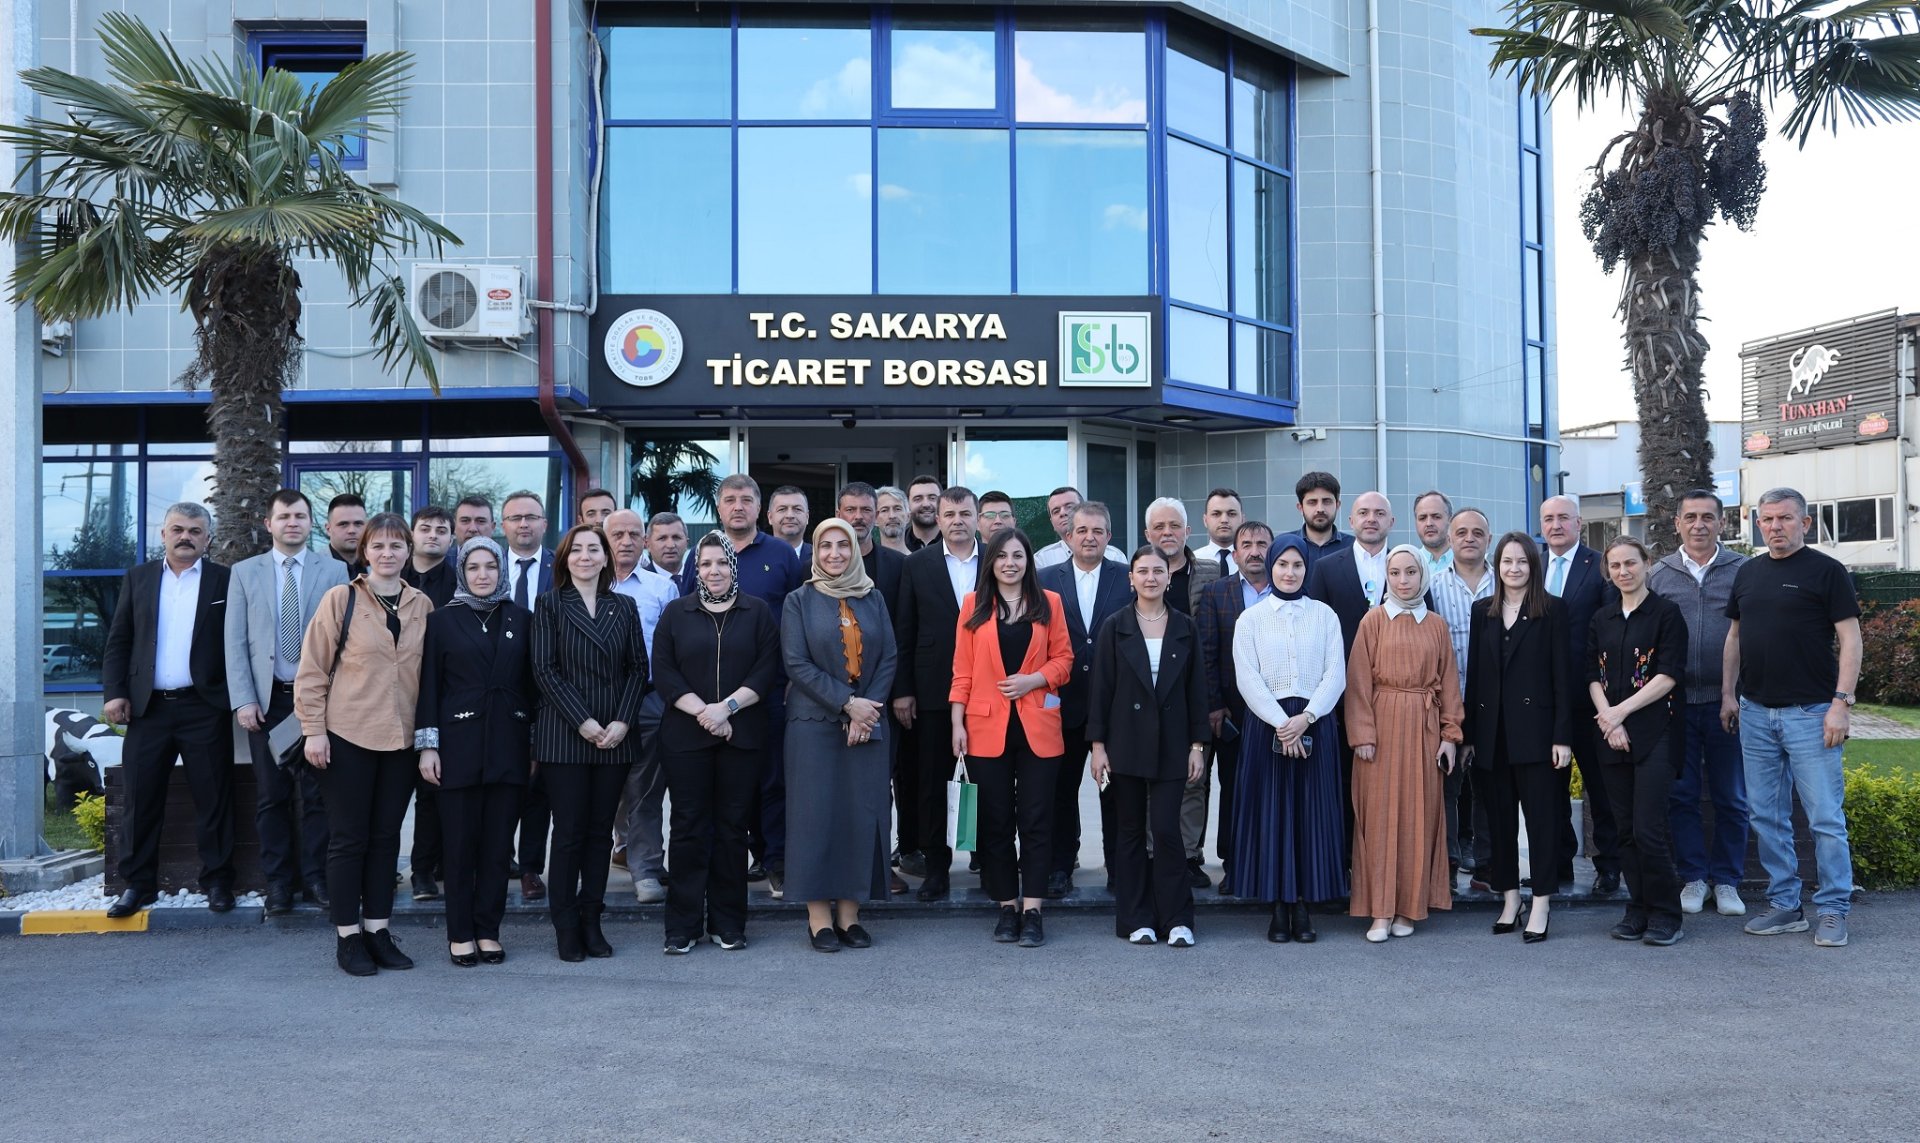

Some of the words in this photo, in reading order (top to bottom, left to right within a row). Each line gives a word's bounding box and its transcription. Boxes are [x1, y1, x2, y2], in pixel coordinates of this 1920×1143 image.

[749, 312, 817, 338] T.C.
[829, 312, 1007, 339] SAKARYA
[706, 352, 872, 386] TİCARET
[883, 359, 1047, 386] BORSASI
[1779, 396, 1847, 422] TUNAHAN
[1808, 418, 1843, 433] ÜRÜNLERİ
